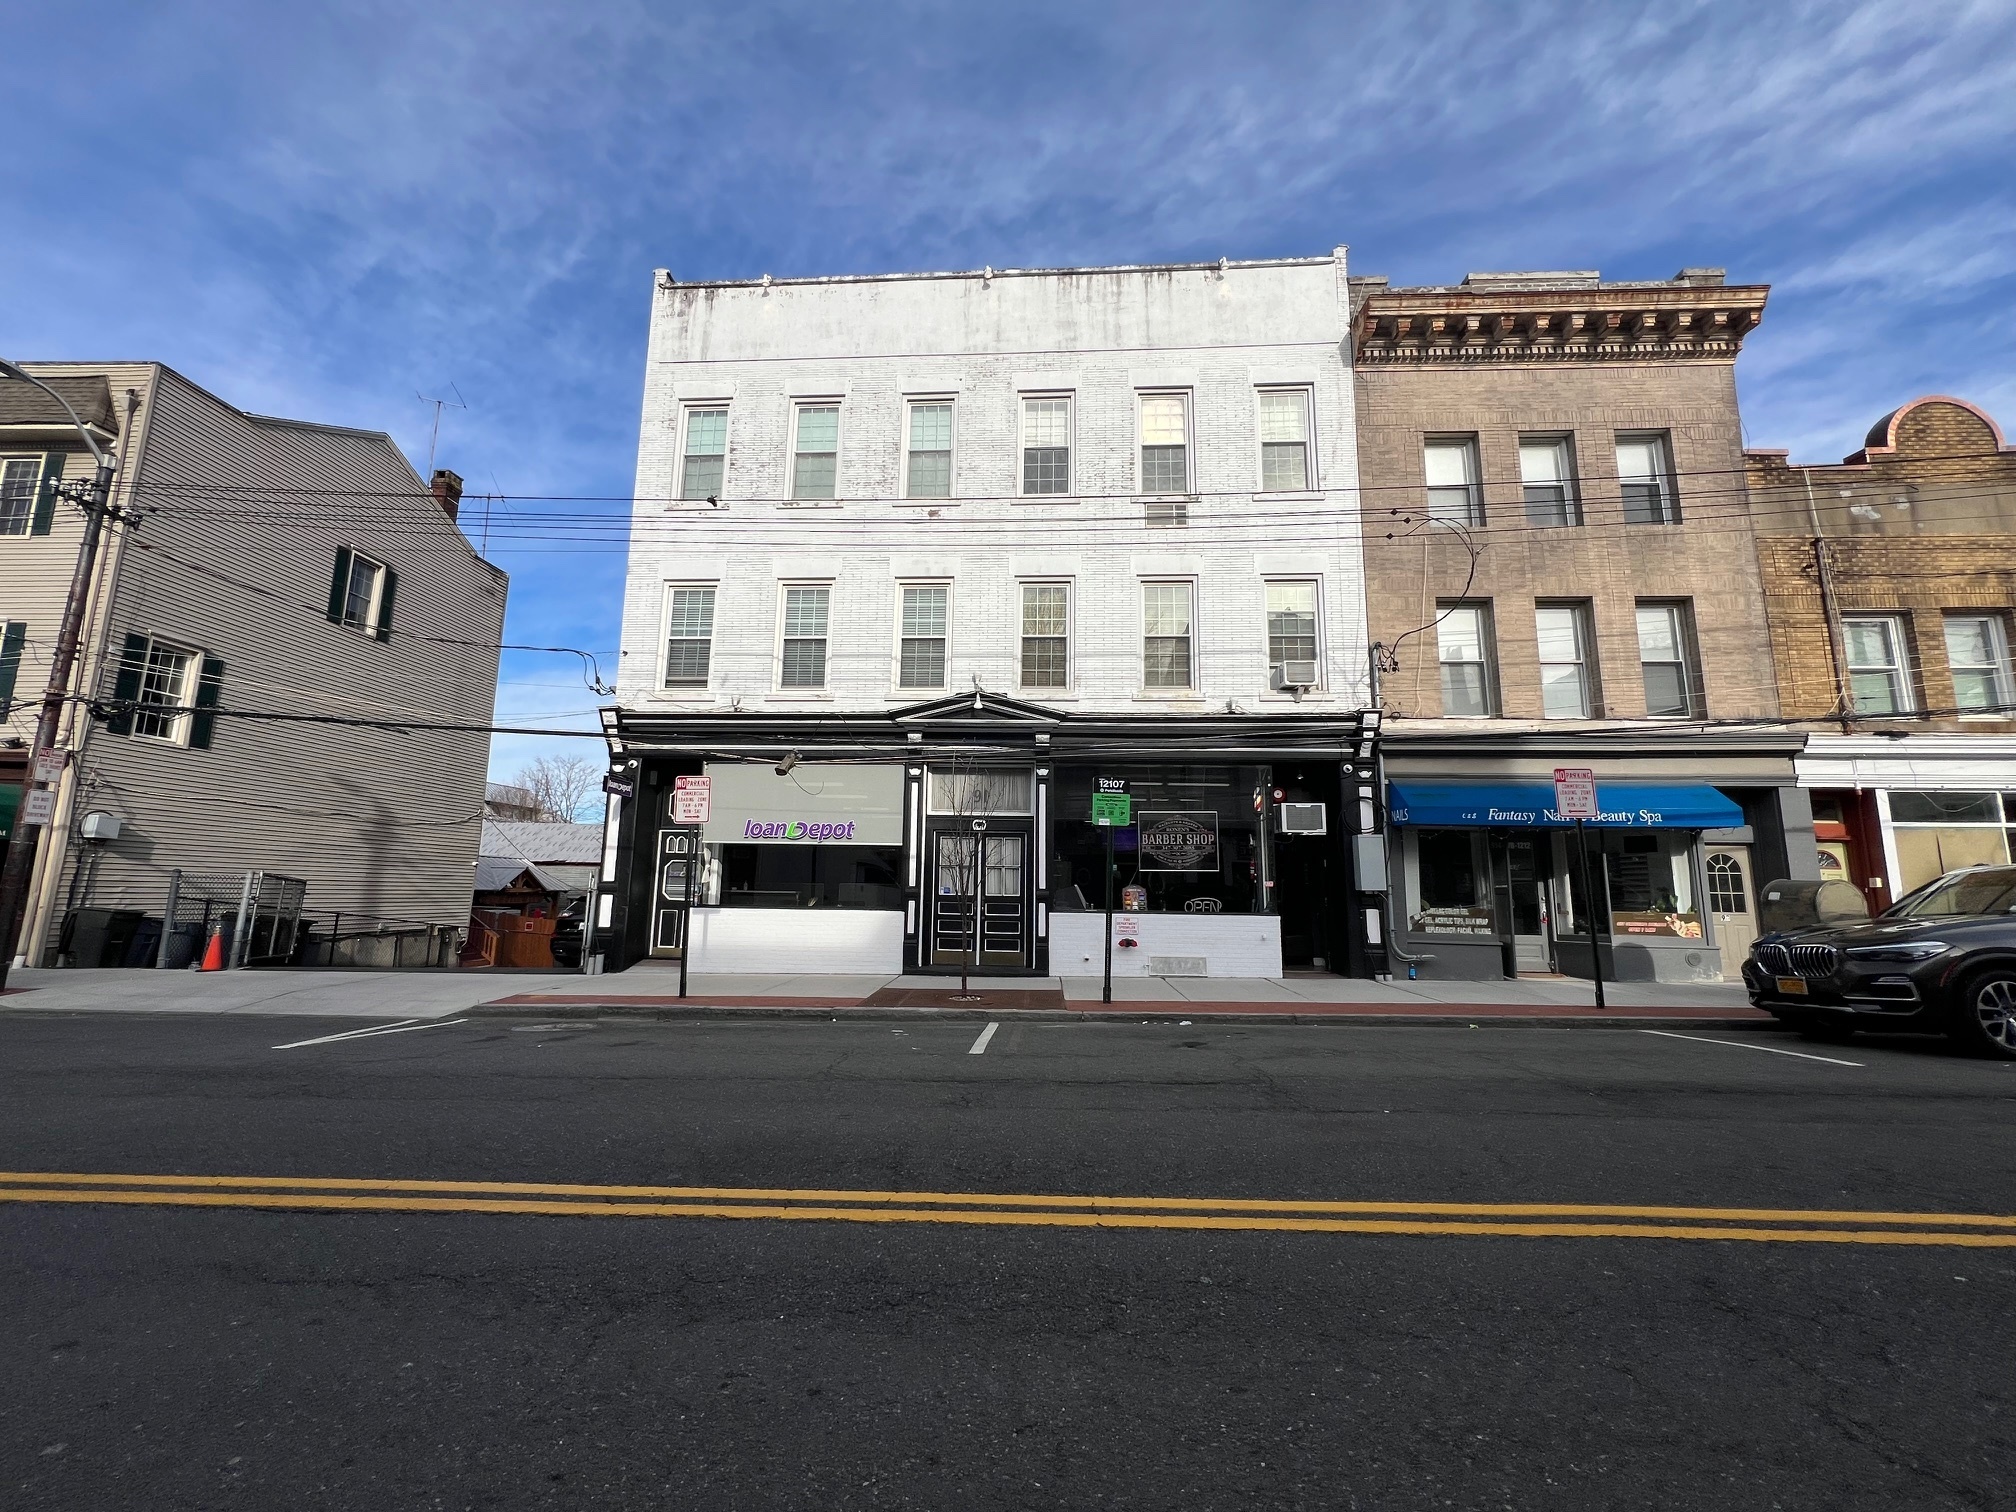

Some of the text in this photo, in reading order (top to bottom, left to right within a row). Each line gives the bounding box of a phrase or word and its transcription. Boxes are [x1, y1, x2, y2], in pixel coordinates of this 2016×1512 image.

[40, 748, 50, 756] NO
[1555, 770, 1565, 780] NO
[609, 781, 632, 792] loanDepot
[677, 778, 686, 788] NO
[1099, 780, 1125, 788] 12107
[1391, 808, 1408, 821] NAILS
[1488, 808, 1536, 824] Fantasy
[1639, 809, 1662, 825] Spa
[744, 819, 855, 842] loanDepot
[1142, 834, 1215, 845] BARBER SHOP
[1184, 900, 1222, 912] OPEN
